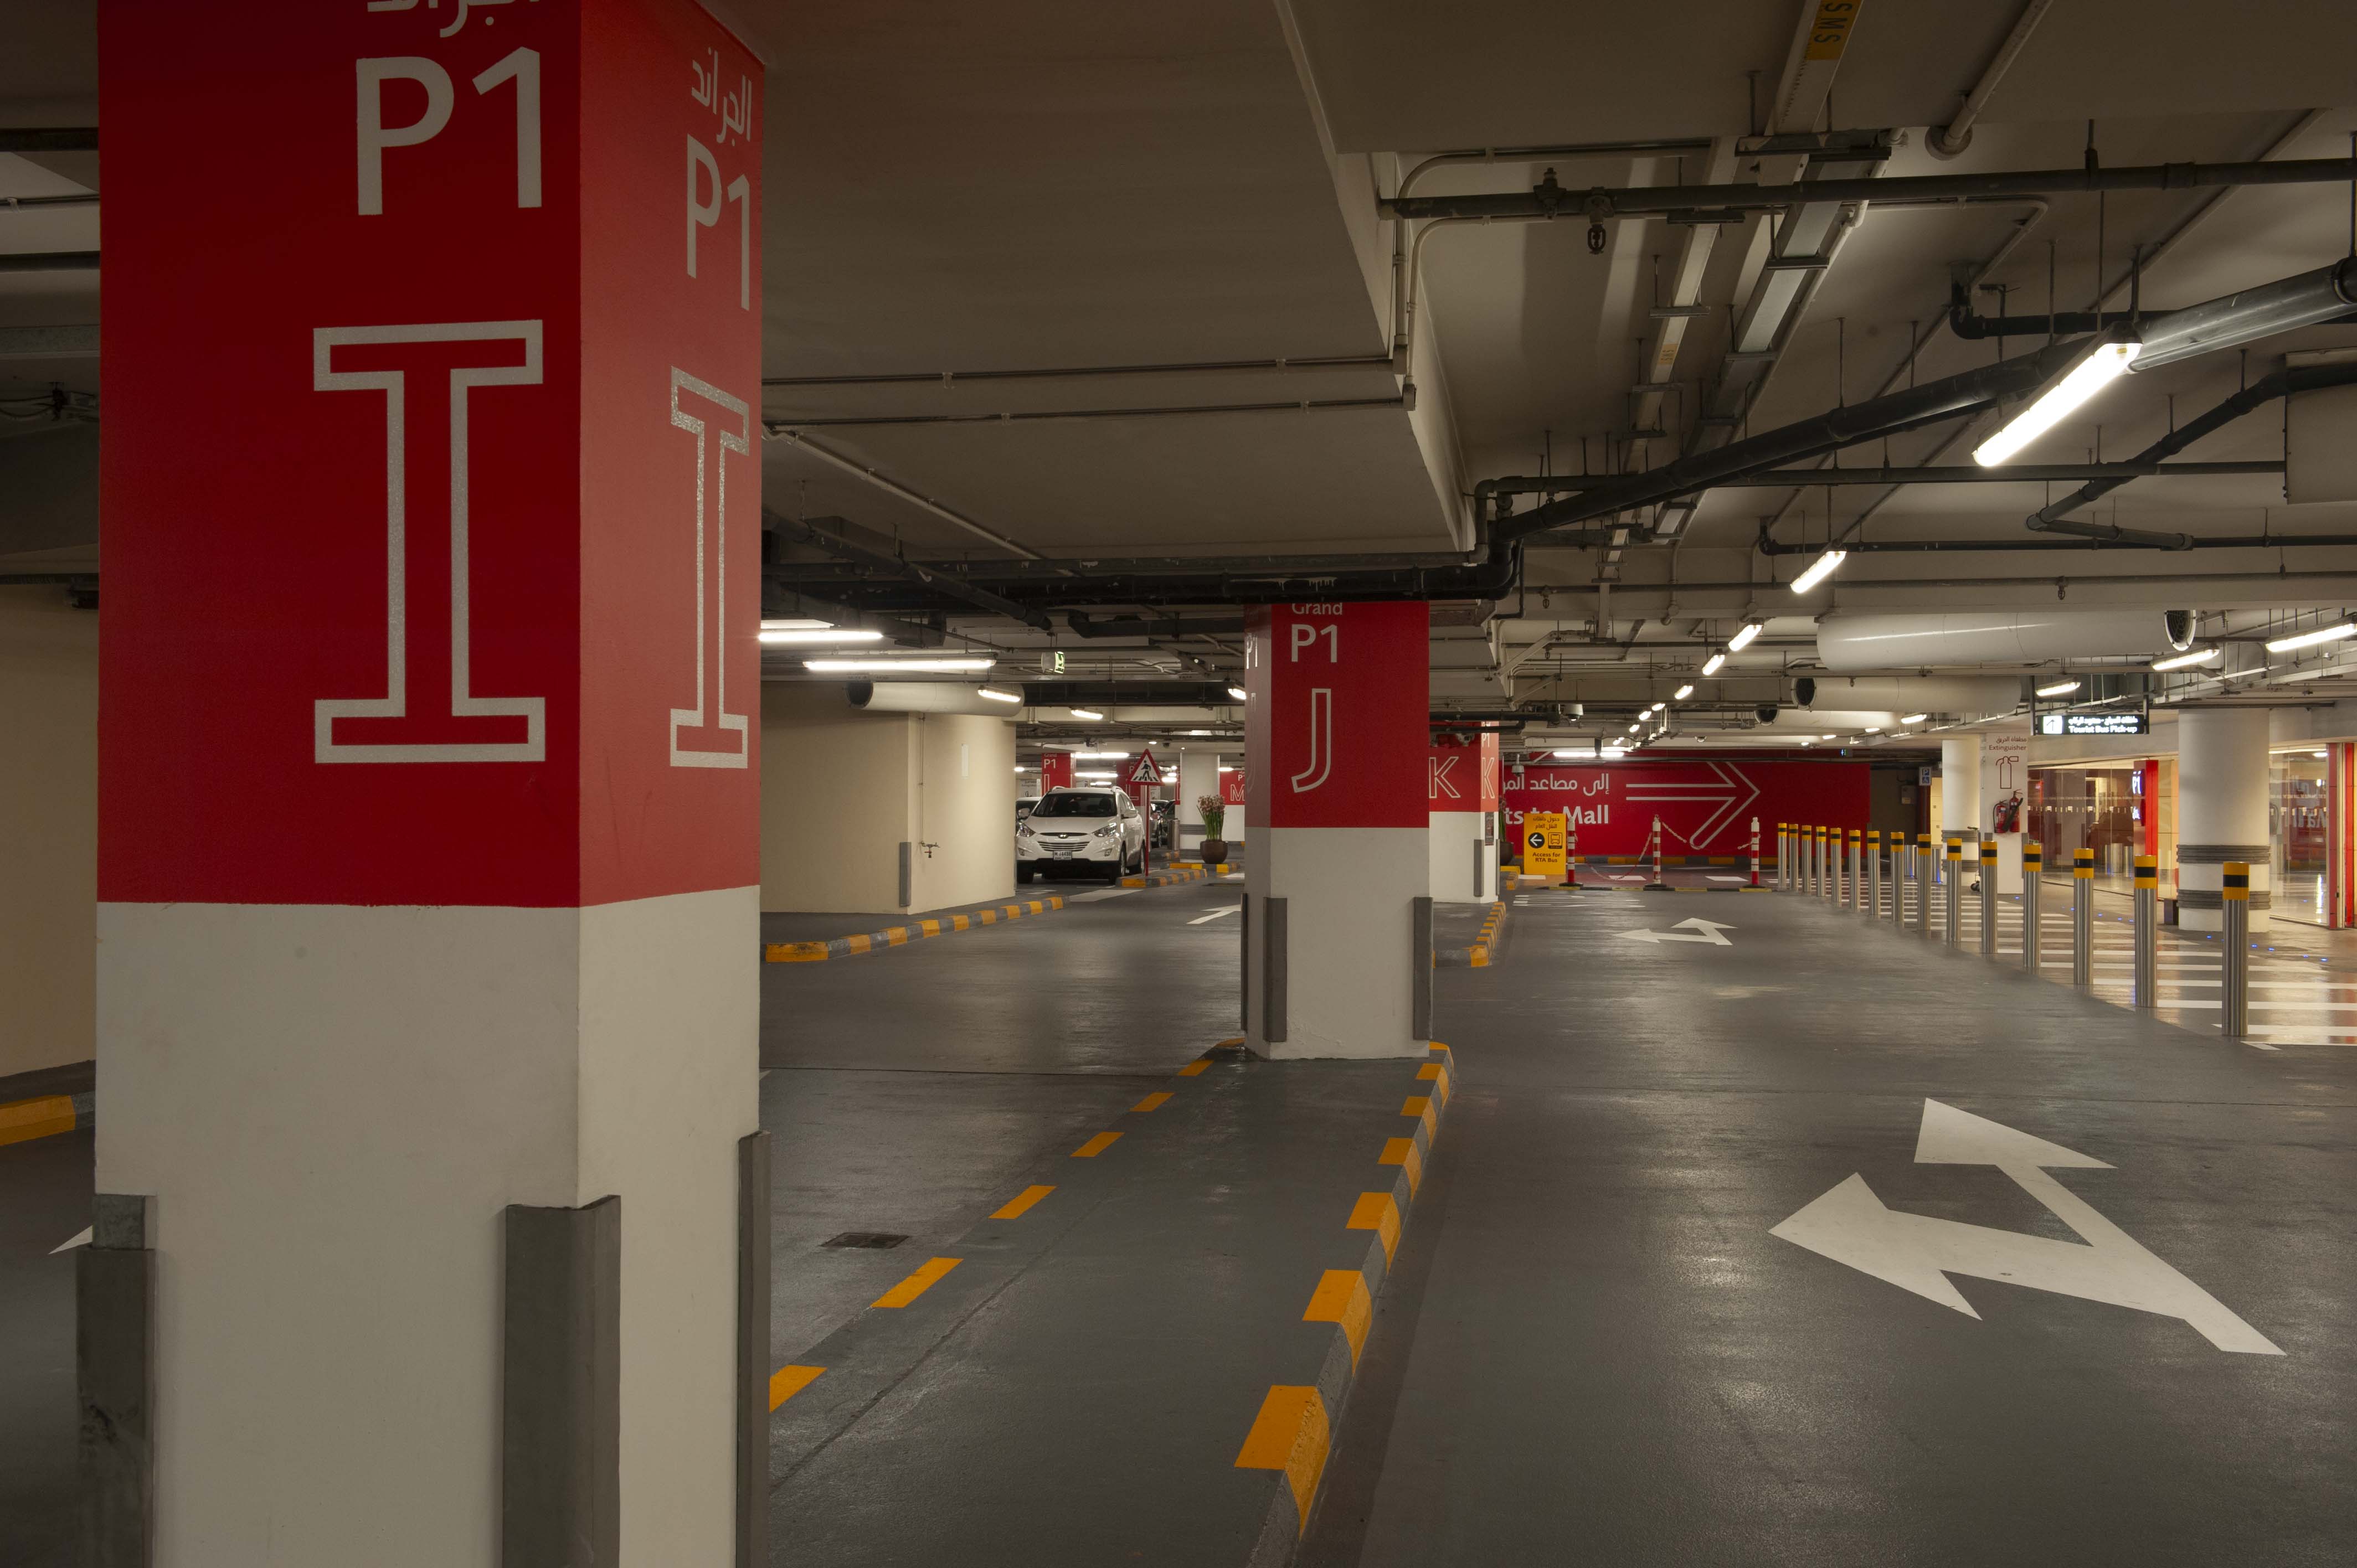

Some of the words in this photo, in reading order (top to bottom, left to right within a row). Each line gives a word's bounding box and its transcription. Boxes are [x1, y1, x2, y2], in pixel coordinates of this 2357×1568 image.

[691, 47, 752, 147] الجراند
[356, 46, 542, 215] P1
[687, 133, 750, 311] P1
[313, 319, 547, 767] I
[669, 365, 750, 771] I
[1291, 602, 1343, 616] Grand
[1291, 624, 1337, 663] P1
[1291, 688, 1331, 793] J
[2109, 725, 2137, 734] Pick-up
[1044, 759, 1056, 769] P1
[1429, 756, 1461, 798] K
[1481, 756, 1495, 799] K
[1530, 773, 1577, 791] مصاعد
[1230, 784, 1245, 802] M
[1582, 773, 1609, 796] إلى
[1562, 804, 1609, 824] Mall
